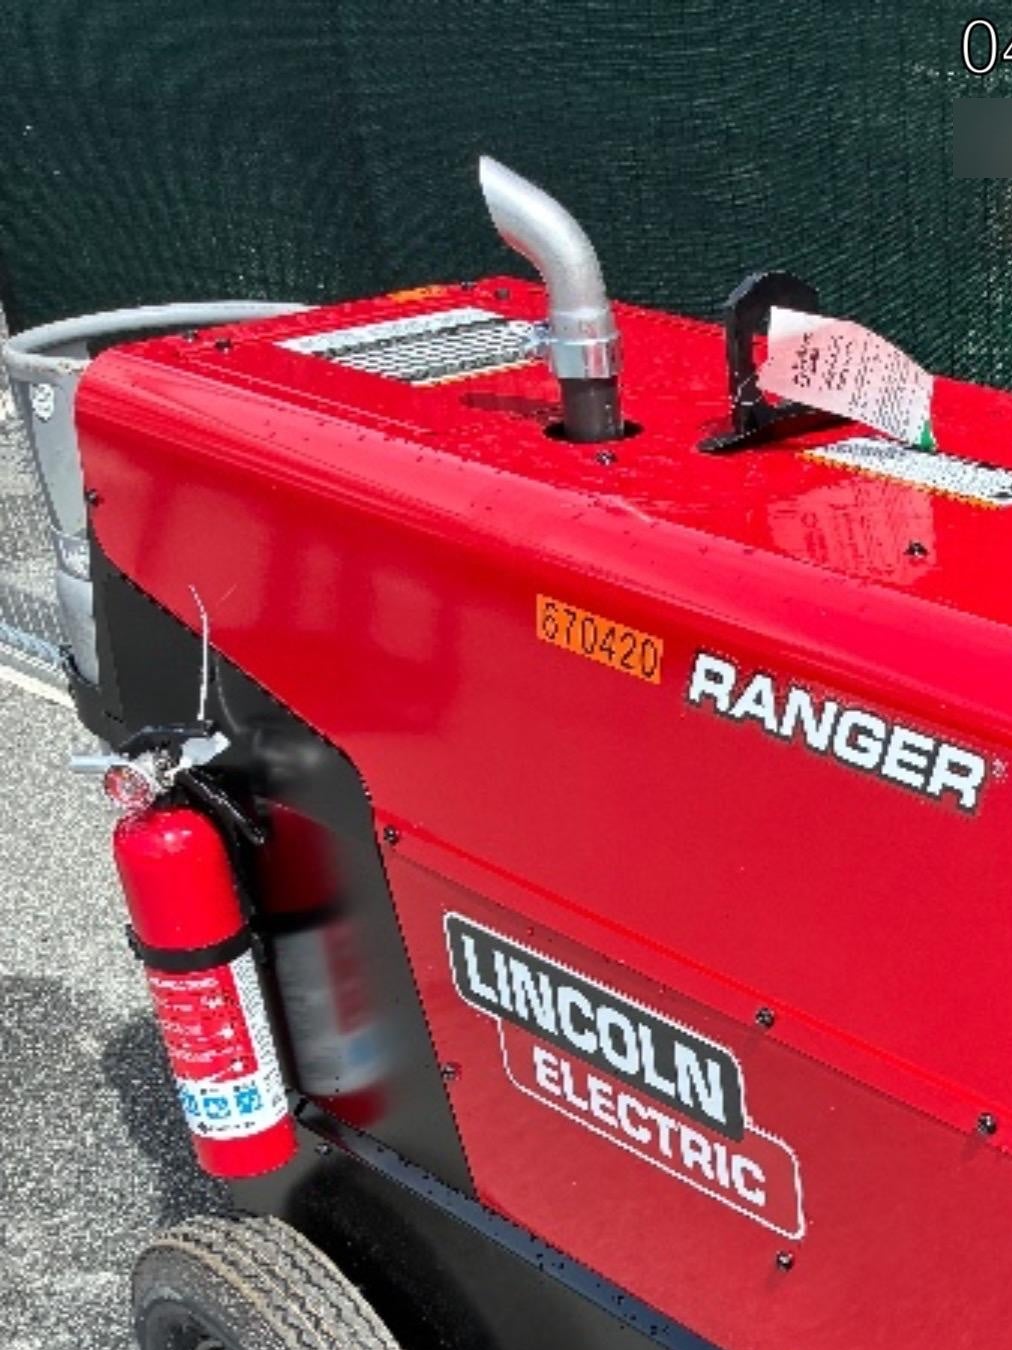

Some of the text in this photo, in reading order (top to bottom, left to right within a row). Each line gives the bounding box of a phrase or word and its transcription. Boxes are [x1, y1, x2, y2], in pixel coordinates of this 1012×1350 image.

[541, 601, 659, 680] 670420
[686, 651, 988, 811] RANGER
[461, 934, 727, 1125] LINCOLN
[532, 1045, 767, 1207] ELECTRIC
